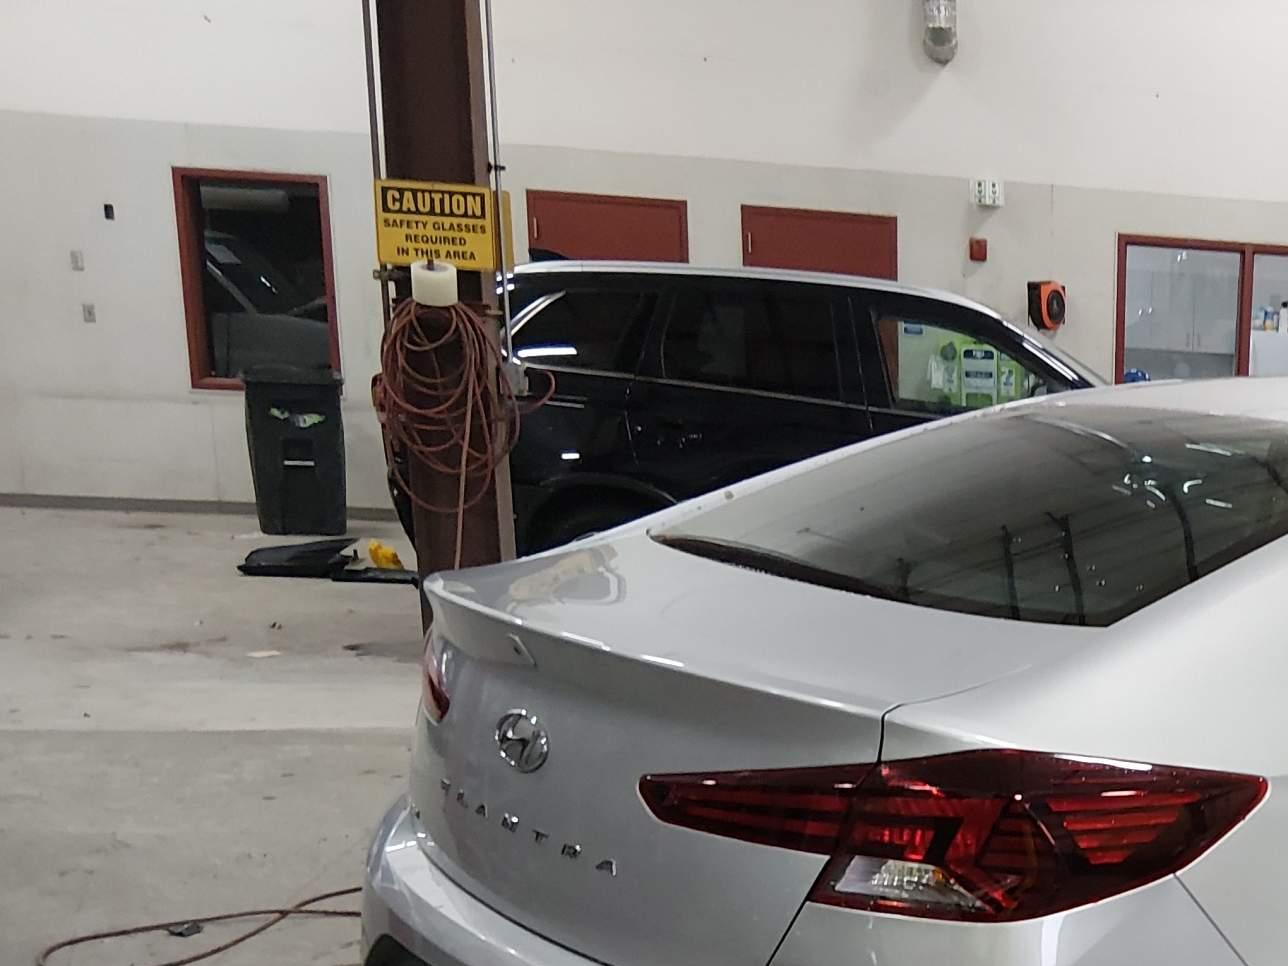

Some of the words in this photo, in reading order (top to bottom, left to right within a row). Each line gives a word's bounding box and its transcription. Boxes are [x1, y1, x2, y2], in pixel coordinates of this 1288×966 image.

[386, 189, 482, 217] CAUTION
[383, 218, 428, 230] SAFETY
[432, 221, 487, 235] GLASSES
[405, 233, 467, 247] REQUIRED
[396, 246, 409, 257] IN
[413, 247, 441, 260] THIS
[445, 250, 476, 261] AREA
